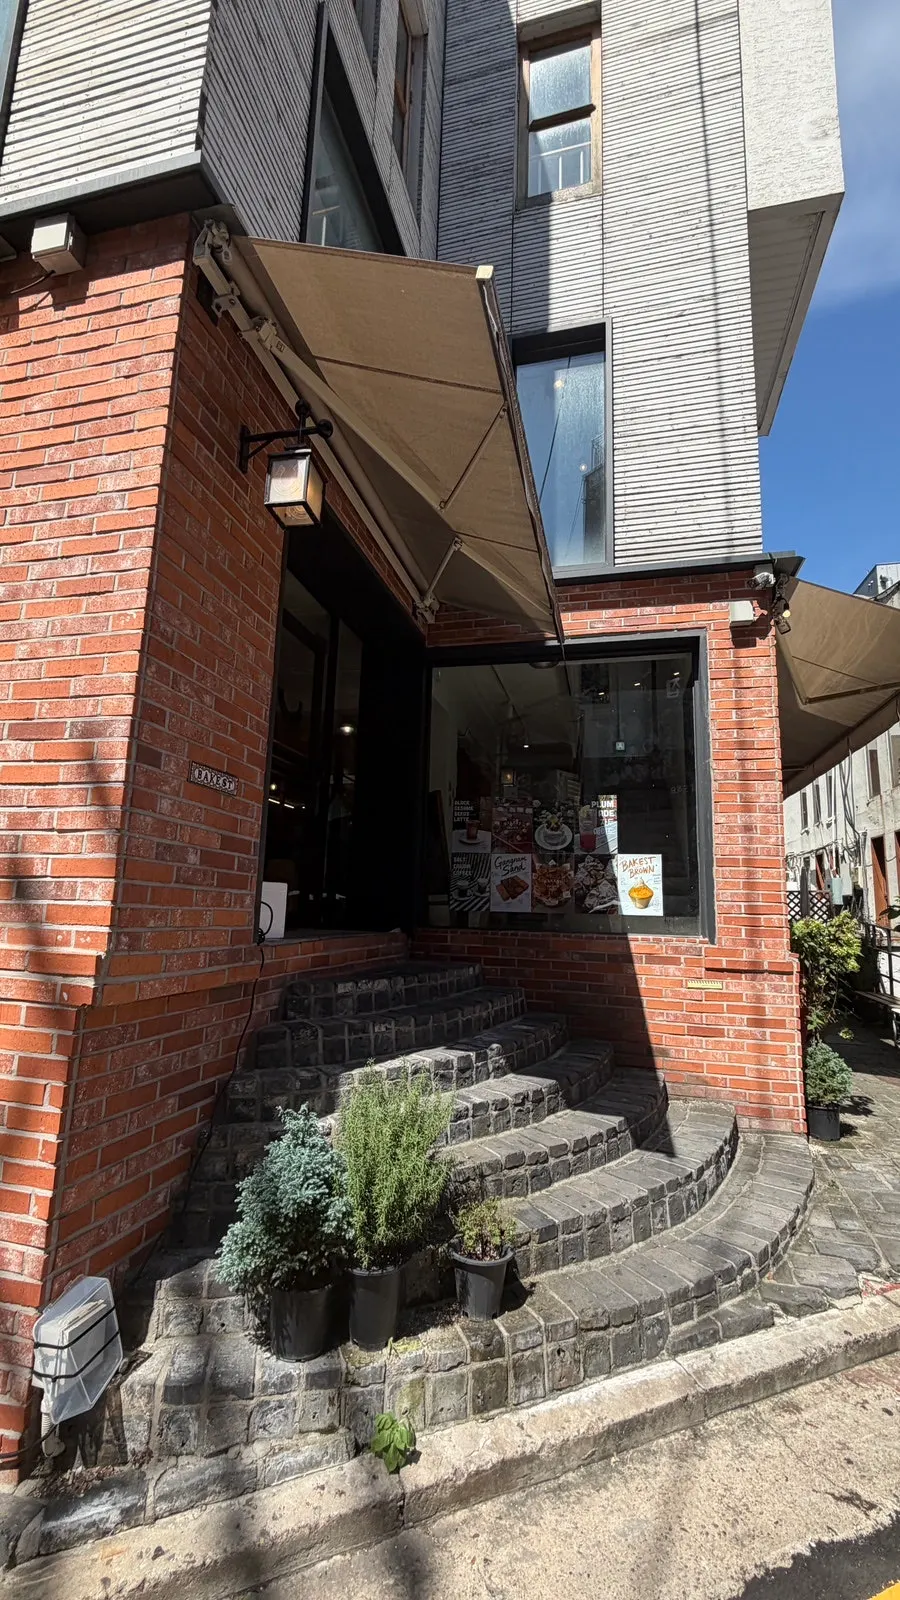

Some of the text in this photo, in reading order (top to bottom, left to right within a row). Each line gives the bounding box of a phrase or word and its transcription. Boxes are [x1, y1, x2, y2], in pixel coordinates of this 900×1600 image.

[197, 769, 233, 790] BAKEST
[621, 856, 656, 872] BAKEST
[629, 865, 654, 878] BROWN
